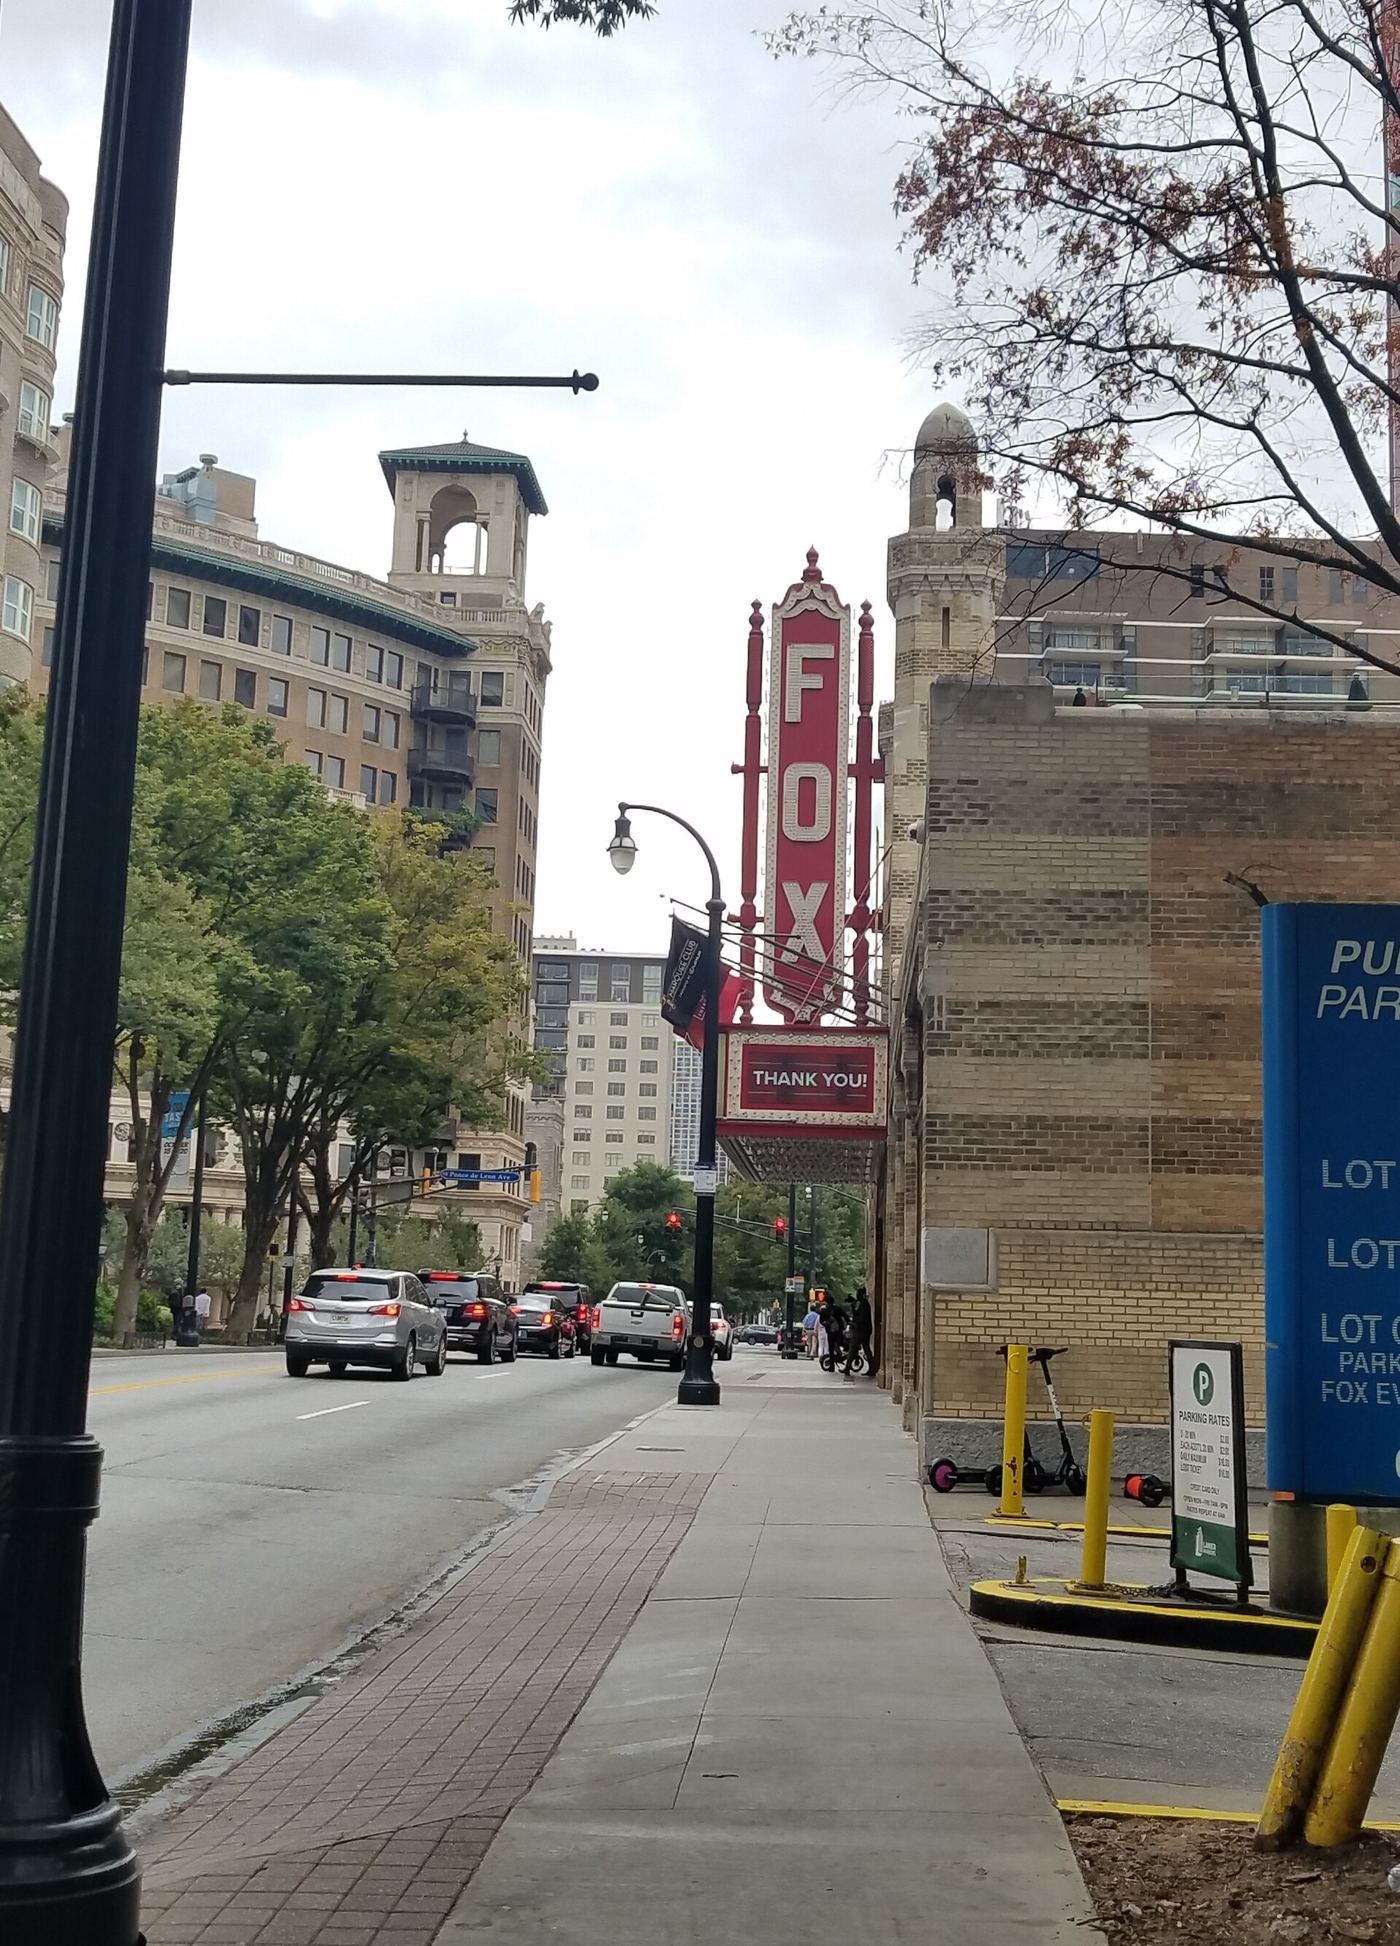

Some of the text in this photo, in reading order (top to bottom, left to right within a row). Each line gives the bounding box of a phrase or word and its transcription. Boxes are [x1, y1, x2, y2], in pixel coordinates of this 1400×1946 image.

[781, 642, 835, 964] FOX
[669, 960, 687, 998] MARQUEE
[682, 940, 697, 963] CLUB
[1330, 939, 1400, 975] PU
[1316, 984, 1400, 1021] PAR
[752, 1070, 868, 1089] THANK YOU!
[1321, 1159, 1397, 1189] LOT
[1327, 1238, 1400, 1269] LOT
[1320, 1312, 1383, 1344] LOT
[1198, 1370, 1210, 1400] P
[1321, 1380, 1369, 1404] FOX
[1178, 1410, 1231, 1427] PARKING RATES
